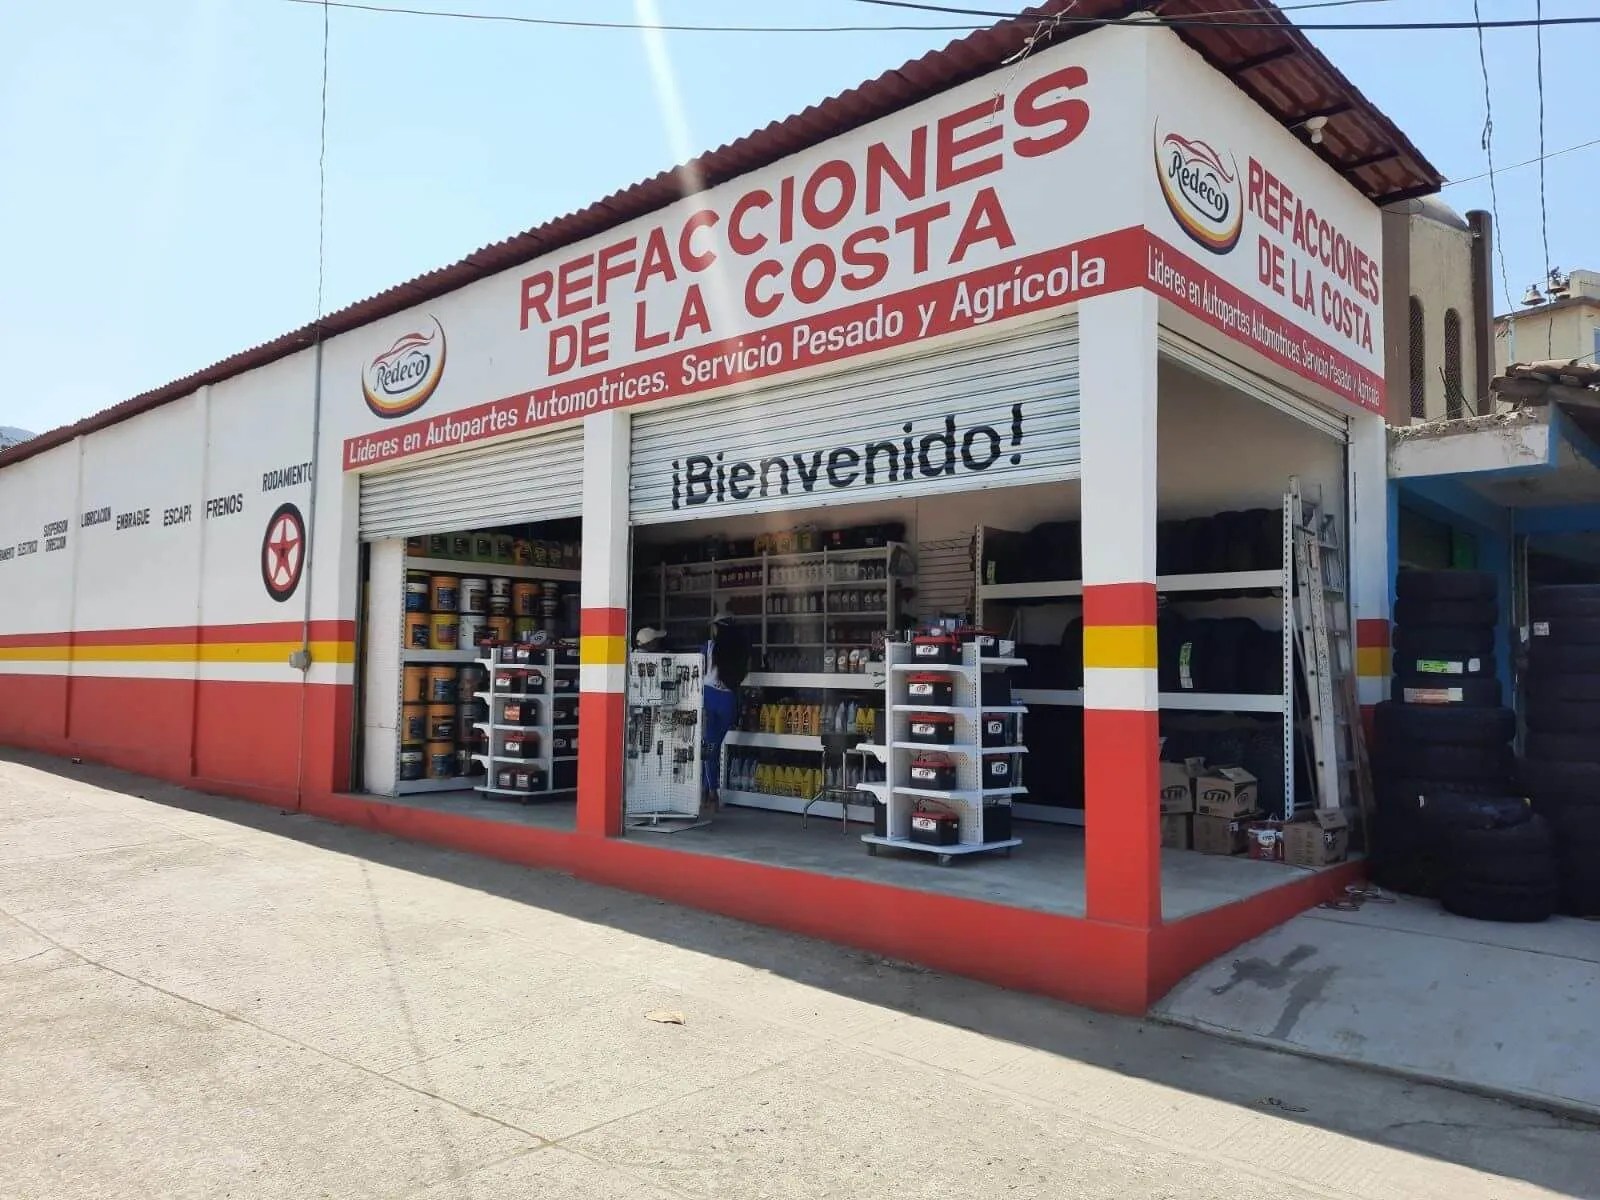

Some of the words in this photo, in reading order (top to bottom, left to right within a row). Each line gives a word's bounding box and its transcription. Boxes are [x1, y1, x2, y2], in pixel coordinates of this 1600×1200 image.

[519, 65, 1090, 331] REFACCIONES
[1168, 150, 1226, 215] Redeco
[1248, 155, 1380, 305] REFACCIONES
[547, 312, 610, 376] DE
[634, 283, 712, 352] LA
[743, 186, 1016, 319] COSTA
[1188, 281, 1201, 308] en
[1202, 279, 1251, 336] Autopartes
[1258, 233, 1285, 297] DE
[1291, 257, 1316, 316] LA
[1321, 280, 1374, 354] COSTA
[373, 358, 425, 392] Redeco
[403, 432, 421, 452] en
[425, 405, 518, 447] Autopartes
[681, 335, 783, 387] Servicio
[792, 303, 904, 361] Pesado
[917, 300, 937, 337] y
[949, 250, 1106, 324] Agrícola
[671, 402, 1024, 511] ¡Bienvenido!
[116, 508, 150, 531] EMBRAGUE
[206, 493, 243, 519] FRENOS
[1203, 790, 1227, 802] LTH
